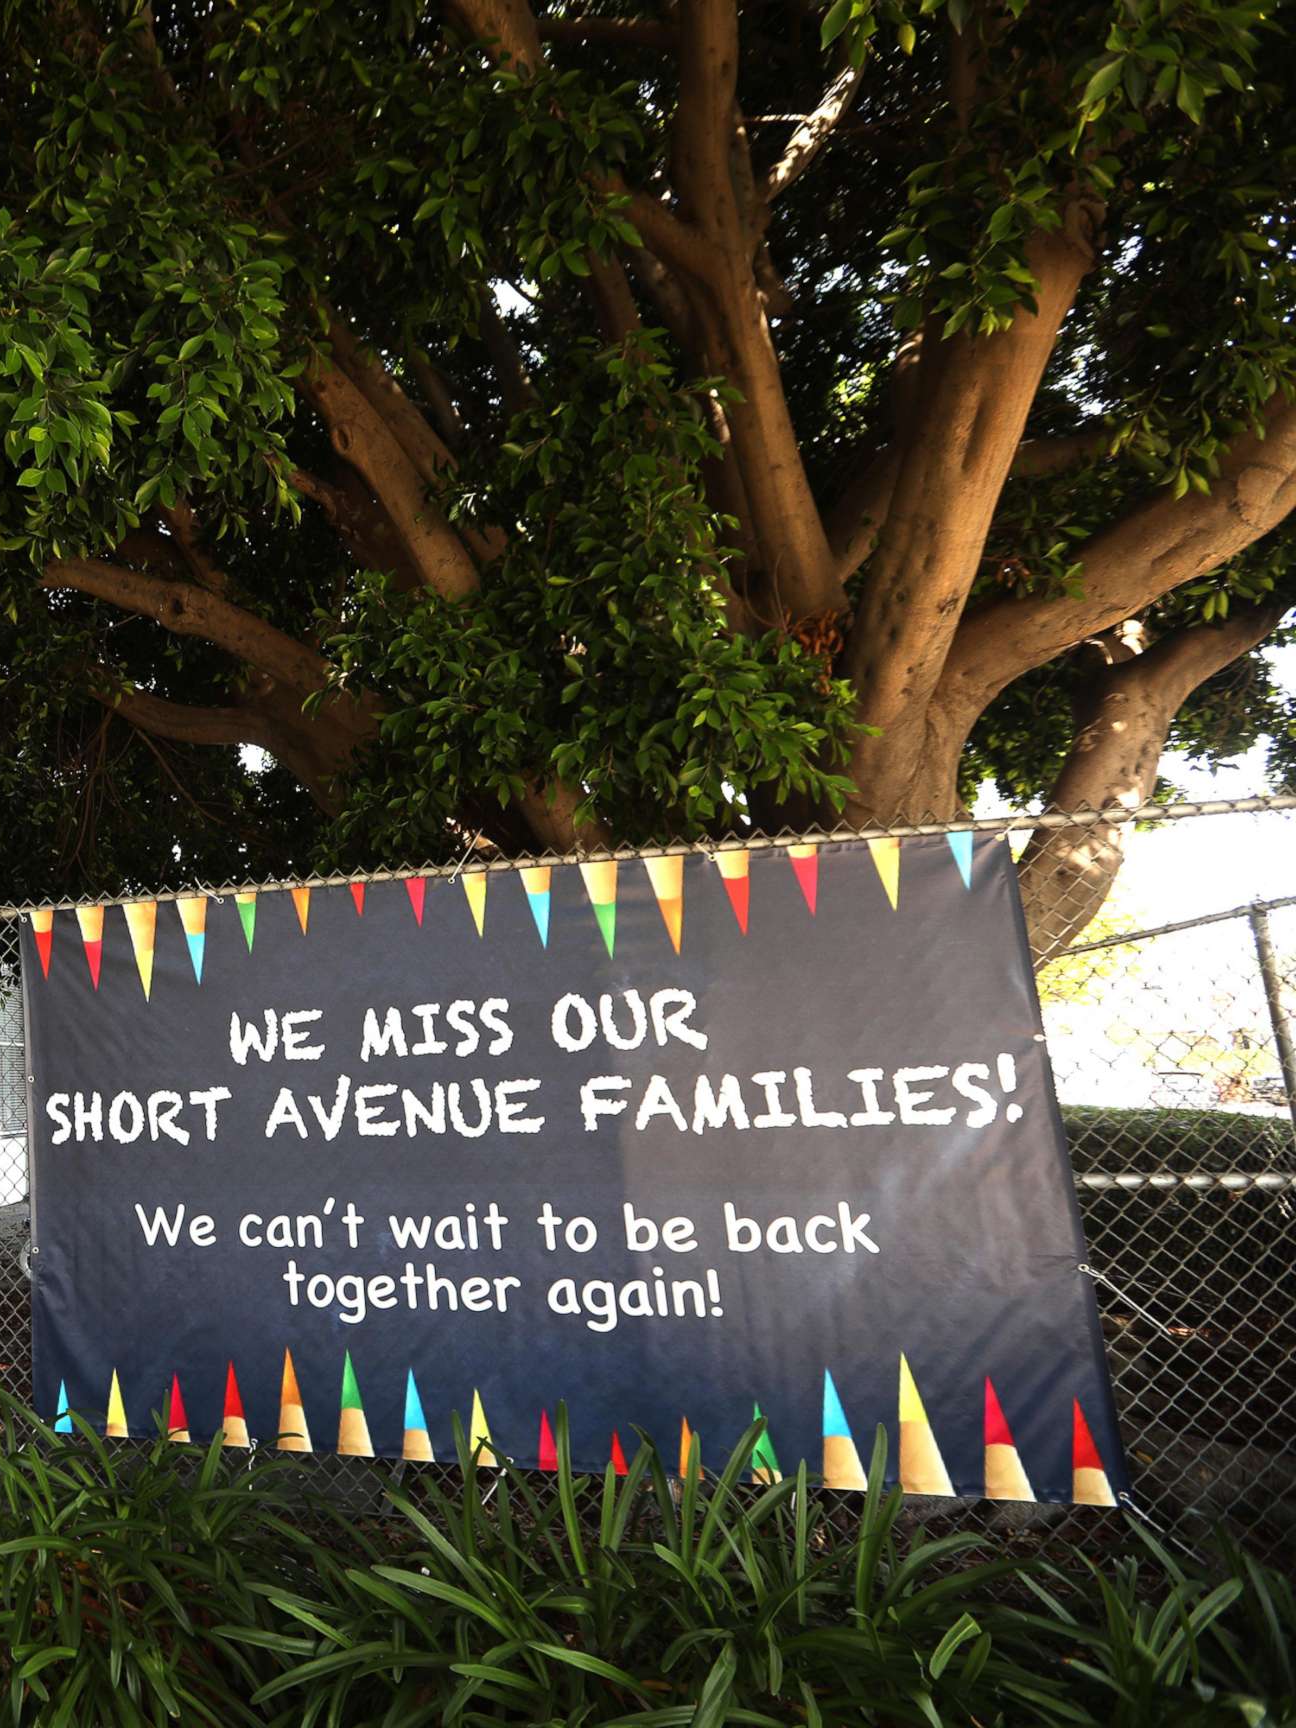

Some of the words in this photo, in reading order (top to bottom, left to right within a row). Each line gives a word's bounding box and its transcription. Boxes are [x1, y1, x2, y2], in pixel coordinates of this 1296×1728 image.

[229, 1008, 325, 1066] WE
[360, 997, 514, 1063] MISS
[551, 988, 708, 1053] OUR
[46, 1086, 232, 1146] SHORT
[265, 1074, 546, 1142] AVENUE
[580, 1053, 1024, 1136] FAMILIES!
[134, 1203, 217, 1248] We
[239, 1197, 365, 1249] can't
[389, 1202, 510, 1251] wait
[537, 1202, 598, 1254] to
[623, 1202, 699, 1254] be
[723, 1201, 881, 1255] back
[282, 1260, 522, 1325] together
[546, 1266, 725, 1333] again!
